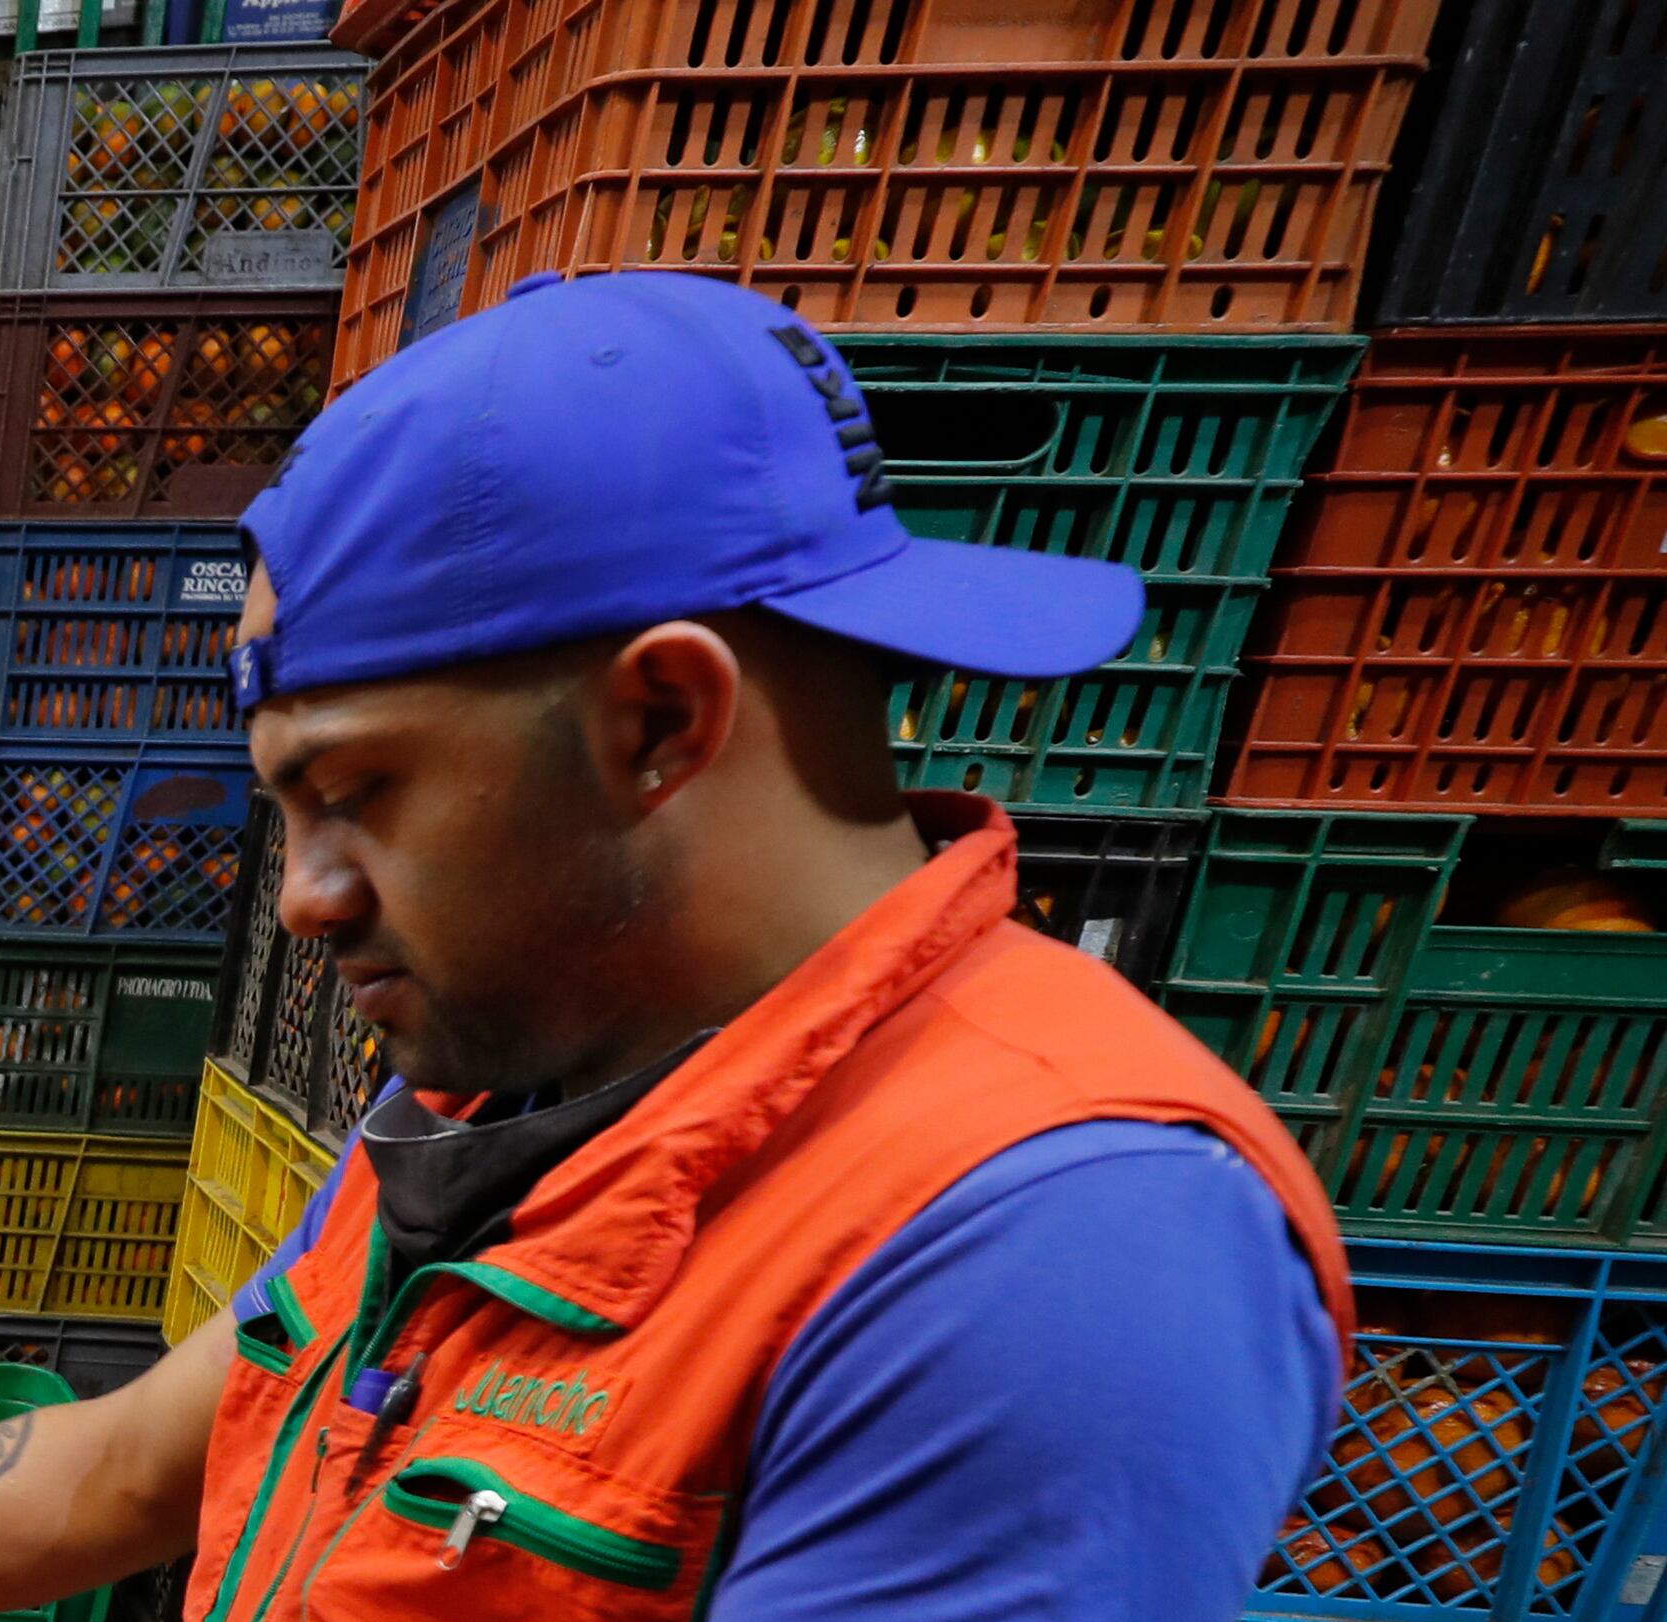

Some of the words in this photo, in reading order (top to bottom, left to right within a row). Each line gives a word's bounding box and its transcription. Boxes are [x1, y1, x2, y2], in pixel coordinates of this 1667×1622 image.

[191, 561, 247, 577] OSCA
[182, 577, 246, 593] RINCO
[455, 1358, 610, 1436] Juancho
